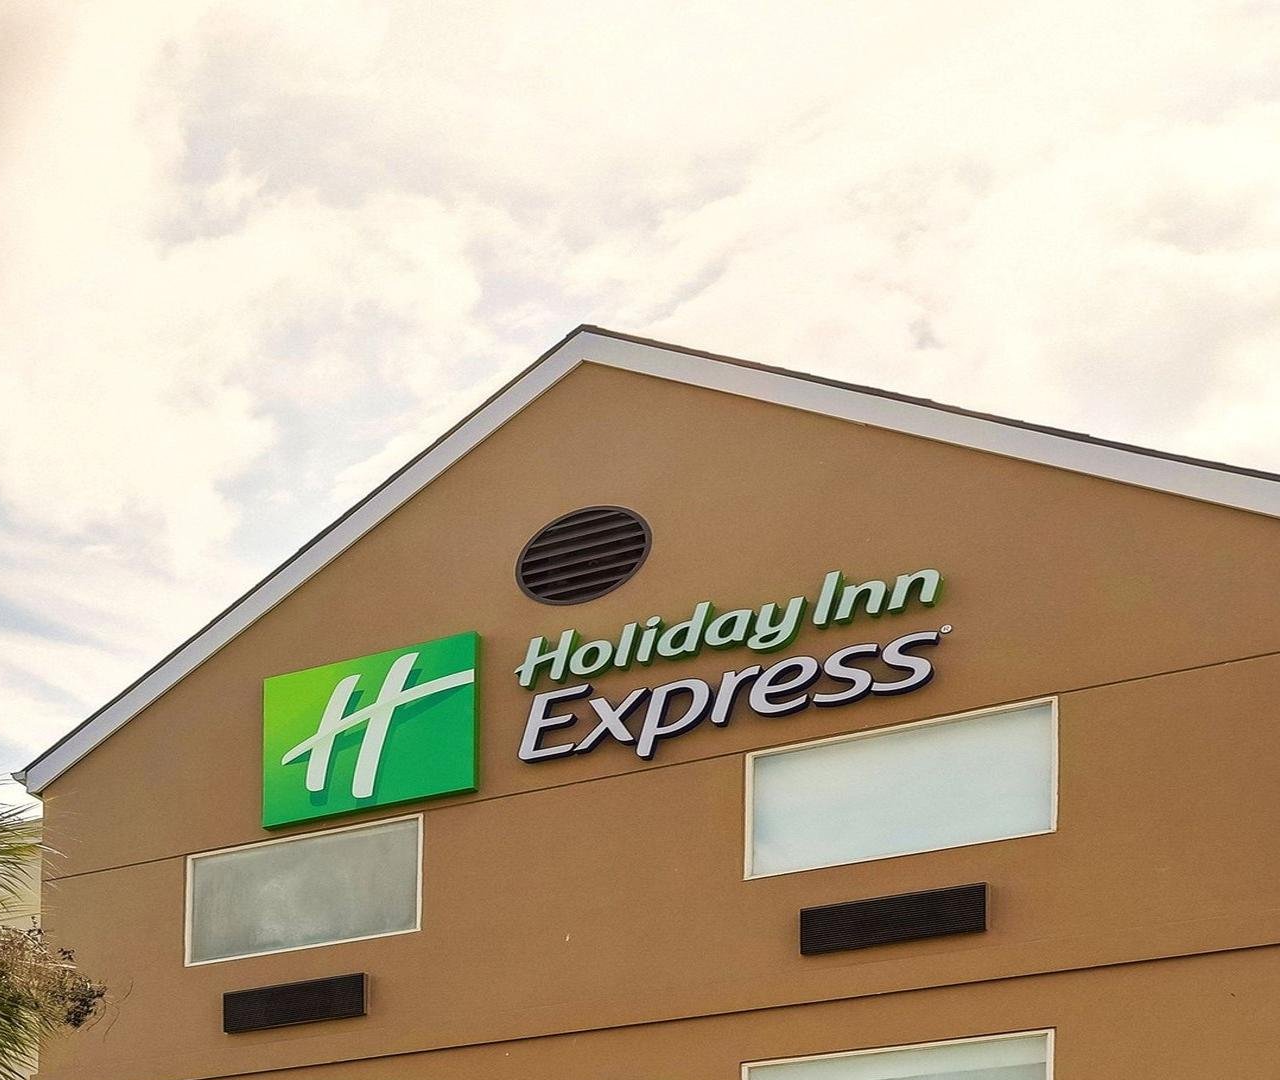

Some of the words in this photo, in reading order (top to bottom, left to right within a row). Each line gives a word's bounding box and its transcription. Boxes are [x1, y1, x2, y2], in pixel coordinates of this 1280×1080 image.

[514, 596, 809, 690] Holiday
[812, 569, 945, 630] Inn
[518, 631, 940, 763] Express
